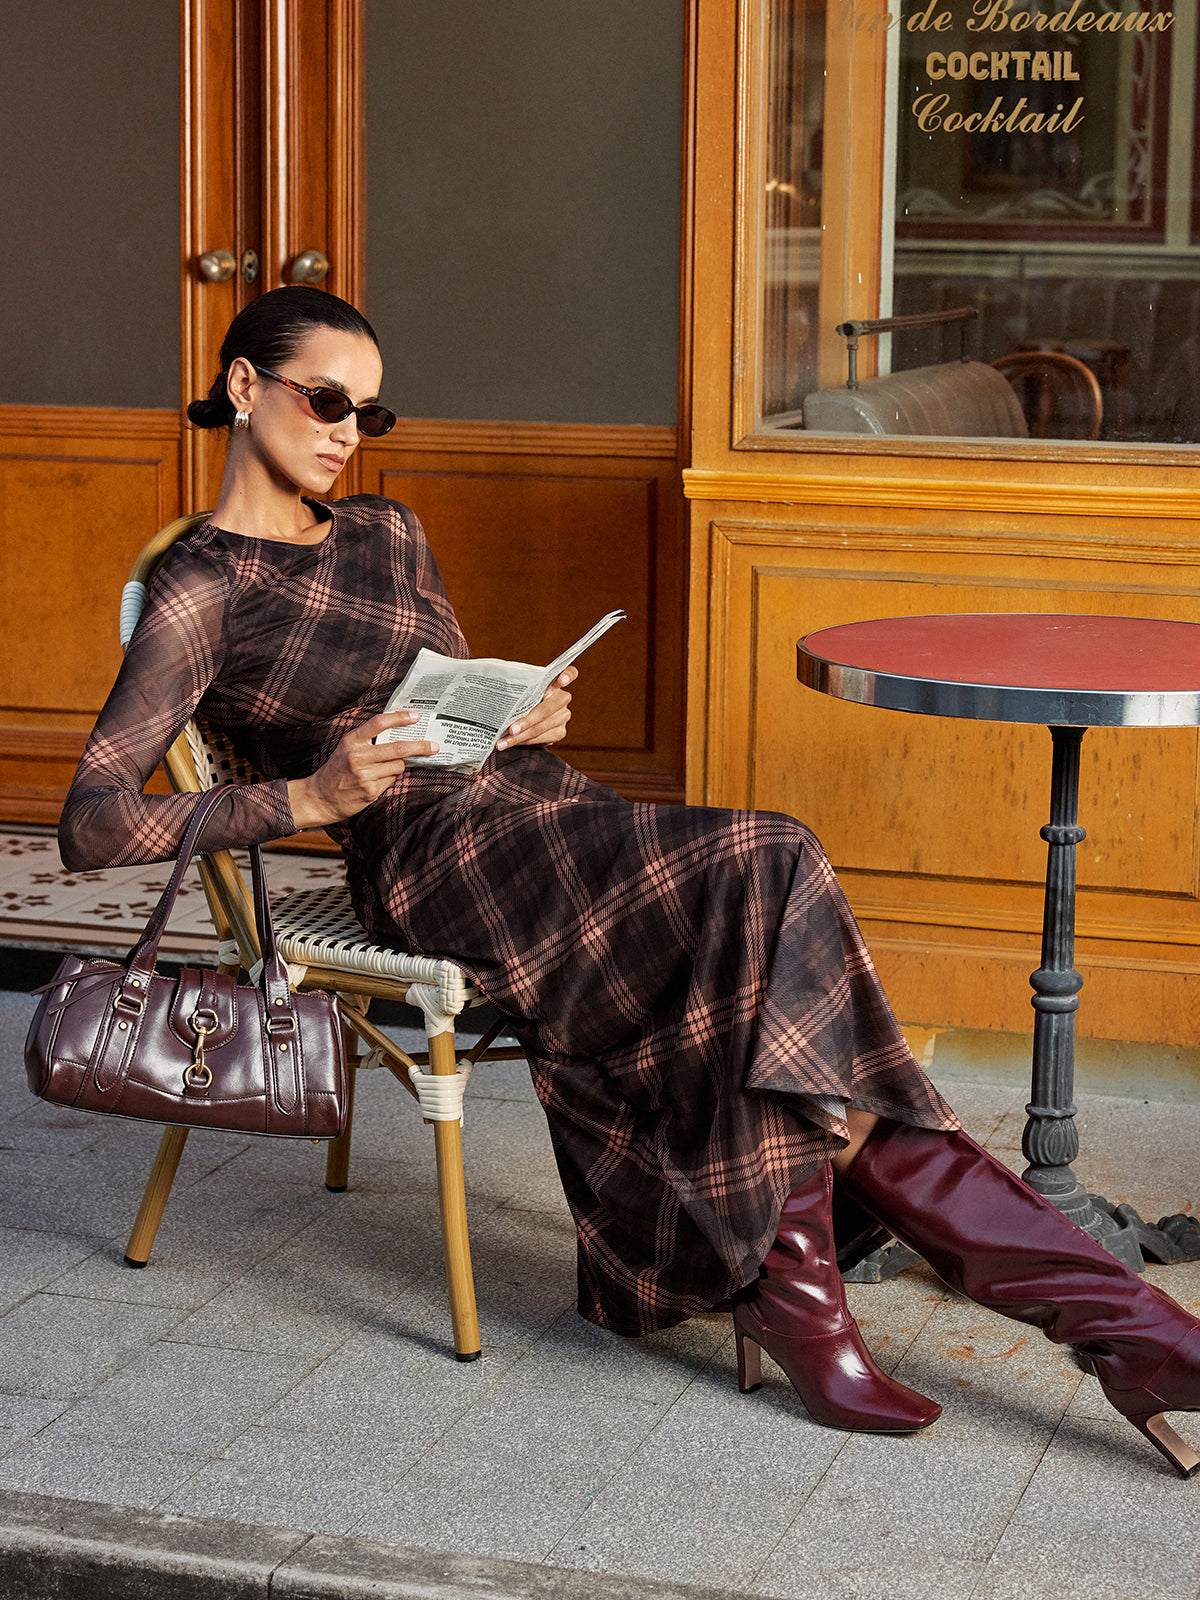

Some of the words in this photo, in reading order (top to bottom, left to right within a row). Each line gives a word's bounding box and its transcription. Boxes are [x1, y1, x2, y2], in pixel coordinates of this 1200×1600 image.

[906, 0, 953, 32] de
[966, 0, 1176, 32] Bordeaux
[926, 51, 1081, 81] COCKTAIL
[912, 93, 1085, 133] Cocktail
